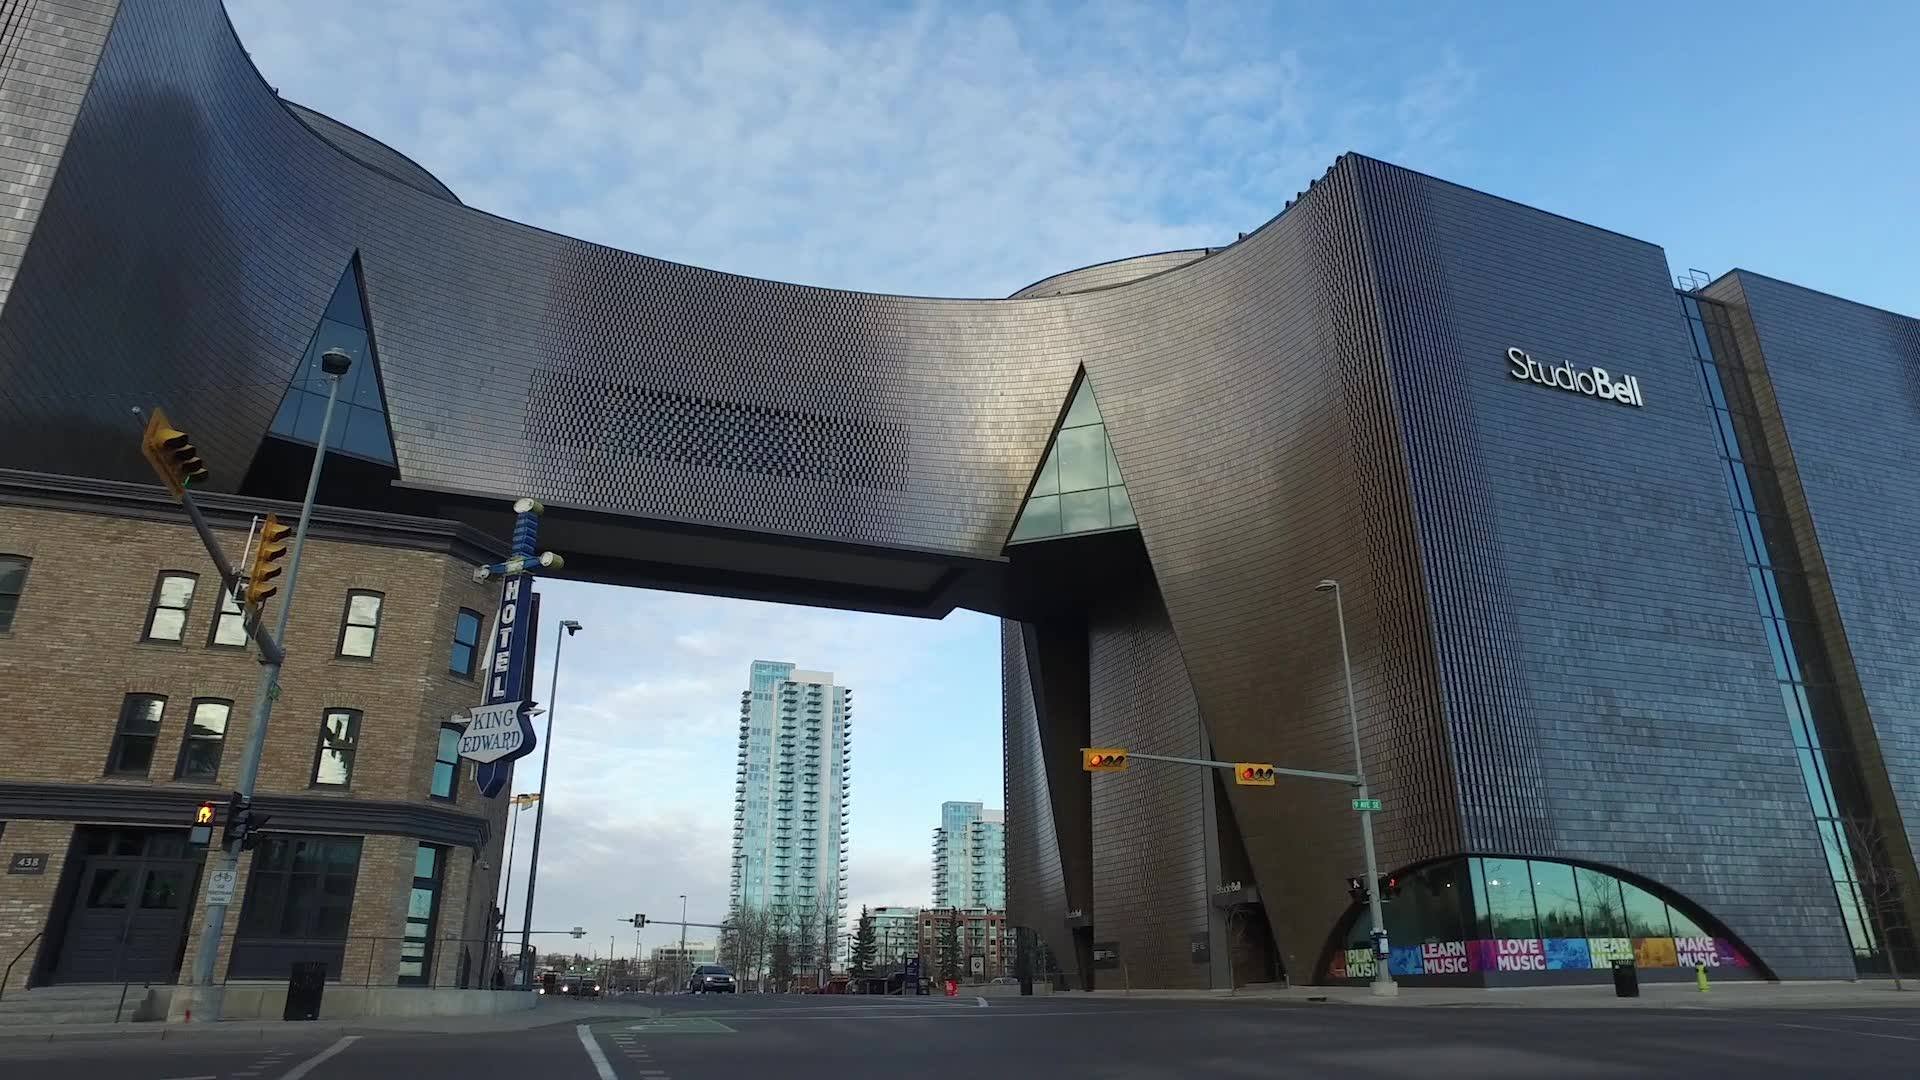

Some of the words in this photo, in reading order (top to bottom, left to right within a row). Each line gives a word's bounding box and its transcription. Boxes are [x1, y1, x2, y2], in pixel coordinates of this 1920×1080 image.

[492, 580, 519, 698] HOTEL
[473, 708, 514, 731] KING
[461, 730, 521, 754] EDWARD
[17, 857, 40, 868] 438
[1422, 941, 1466, 957] LEARN
[1498, 939, 1540, 955] LOVE
[1590, 938, 1631, 954] HEAR
[1675, 937, 1715, 952] MAKE
[1423, 957, 1468, 975] MUSIC
[1497, 955, 1546, 971] MUSIC
[1678, 952, 1720, 967] MUSIC
[1346, 962, 1377, 978] MUSI
